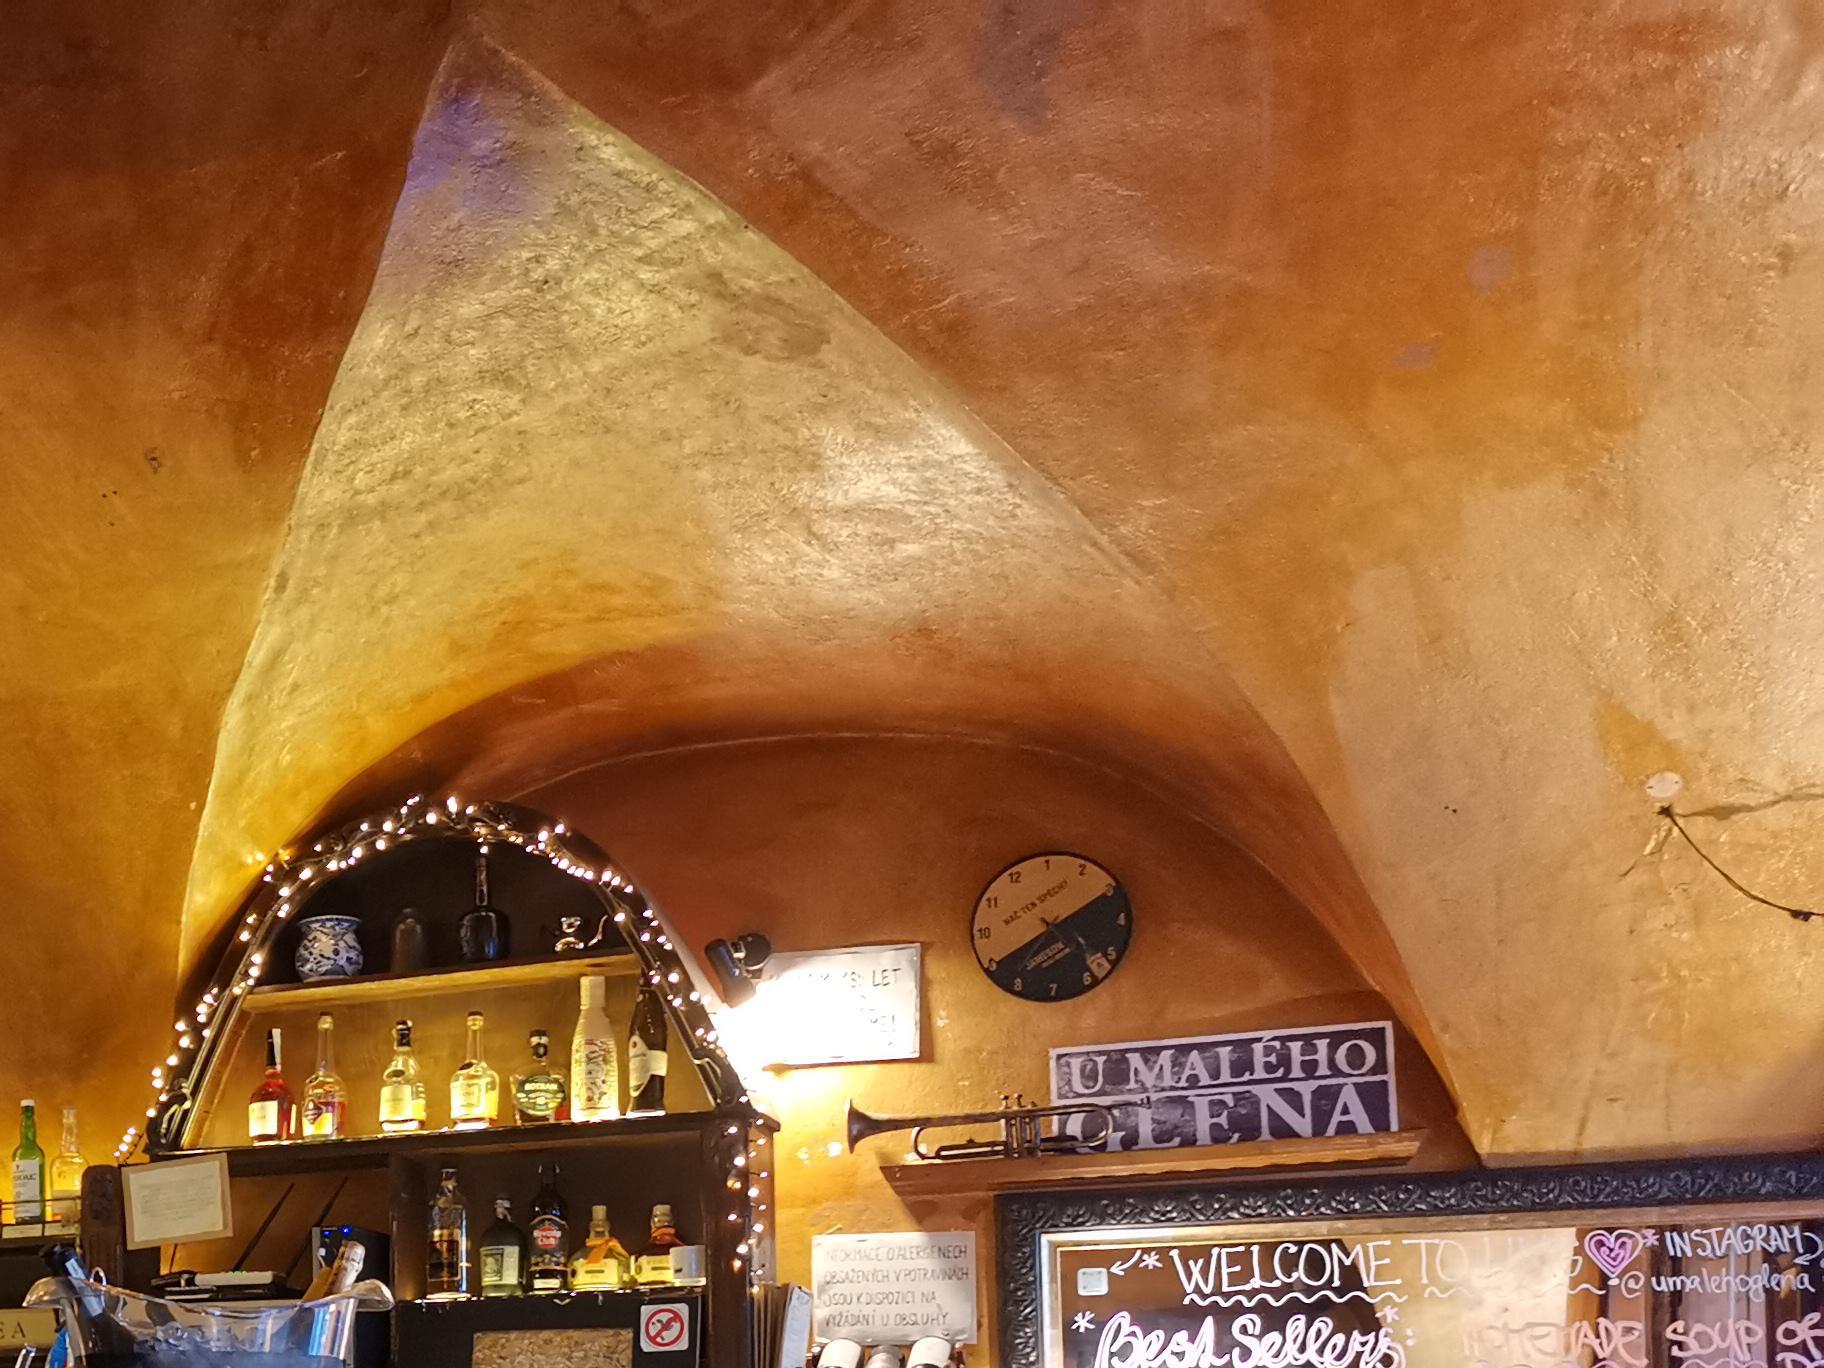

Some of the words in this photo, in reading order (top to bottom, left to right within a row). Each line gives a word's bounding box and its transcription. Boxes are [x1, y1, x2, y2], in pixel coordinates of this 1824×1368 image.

[1044, 859, 1051, 871] 1
[1078, 863, 1087, 877] 2
[1008, 870, 1022, 884] 12
[986, 896, 998, 908] 11
[1116, 912, 1126, 925] 4
[977, 927, 991, 940] 10
[1106, 946, 1116, 960] 5
[872, 968, 902, 987] LET
[1014, 977, 1023, 992] 8
[1082, 971, 1092, 985] 6
[1049, 983, 1058, 997] 7
[1067, 1054, 1107, 1095] U
[1125, 1035, 1377, 1090] MALÉHO
[1665, 1225, 1805, 1258] INSTAGRAM
[1169, 1240, 1402, 1294] WELCOME
[1402, 1239, 1468, 1283] TO
[1652, 1267, 1815, 1303] umalehoglena
[920, 1290, 936, 1303] NA
[881, 1313, 890, 1327] U
[894, 1312, 949, 1327] OBSLUHY
[1666, 1319, 1764, 1360] SOUP
